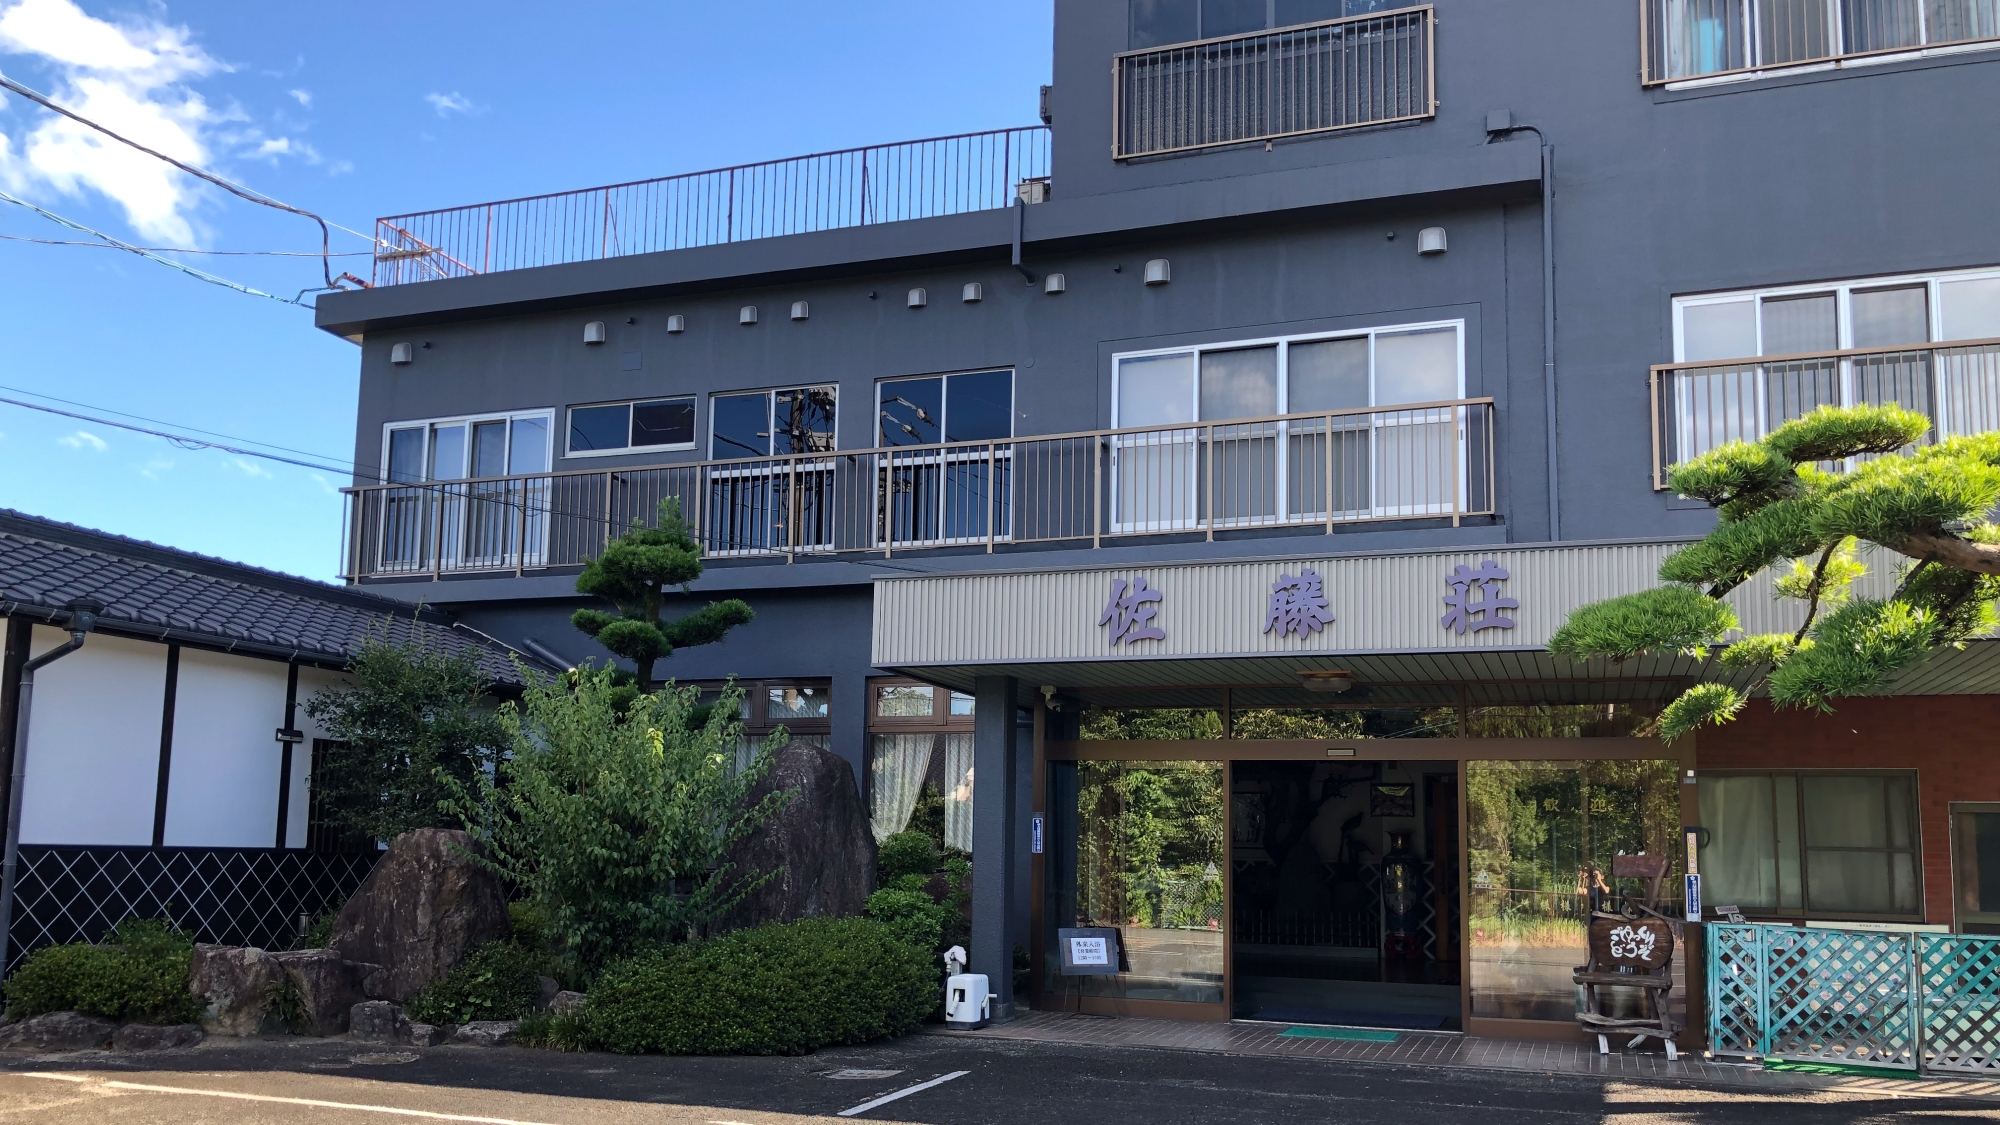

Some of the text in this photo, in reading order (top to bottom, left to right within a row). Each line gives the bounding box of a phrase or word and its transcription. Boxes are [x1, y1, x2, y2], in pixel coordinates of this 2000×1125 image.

[1098, 559, 1519, 647] 佐藤荘
[1609, 925, 1656, 946] ごゆっくり
[1610, 941, 1655, 961] どうぞ
